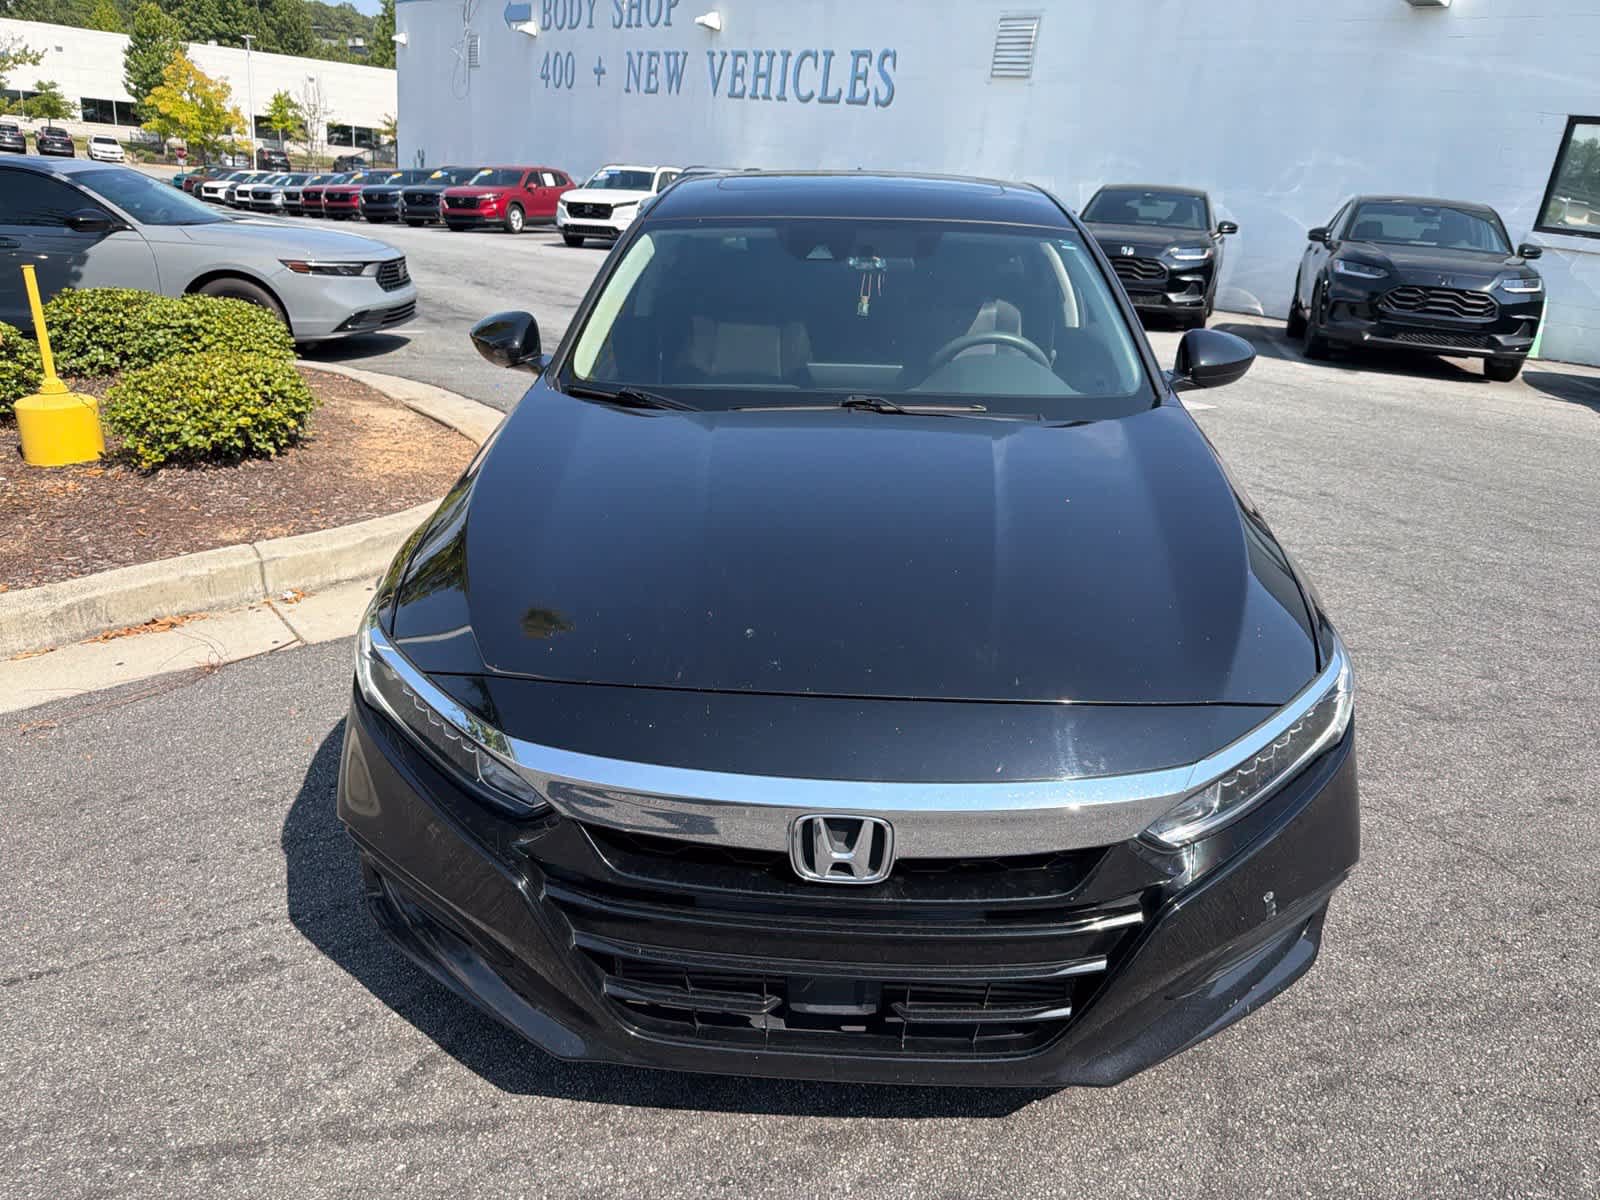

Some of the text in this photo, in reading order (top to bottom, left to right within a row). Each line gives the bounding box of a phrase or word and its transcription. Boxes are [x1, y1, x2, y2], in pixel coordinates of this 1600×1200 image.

[540, 0, 679, 31] BODY SHOP
[539, 48, 898, 108] 400 + NEW VEHICLES
